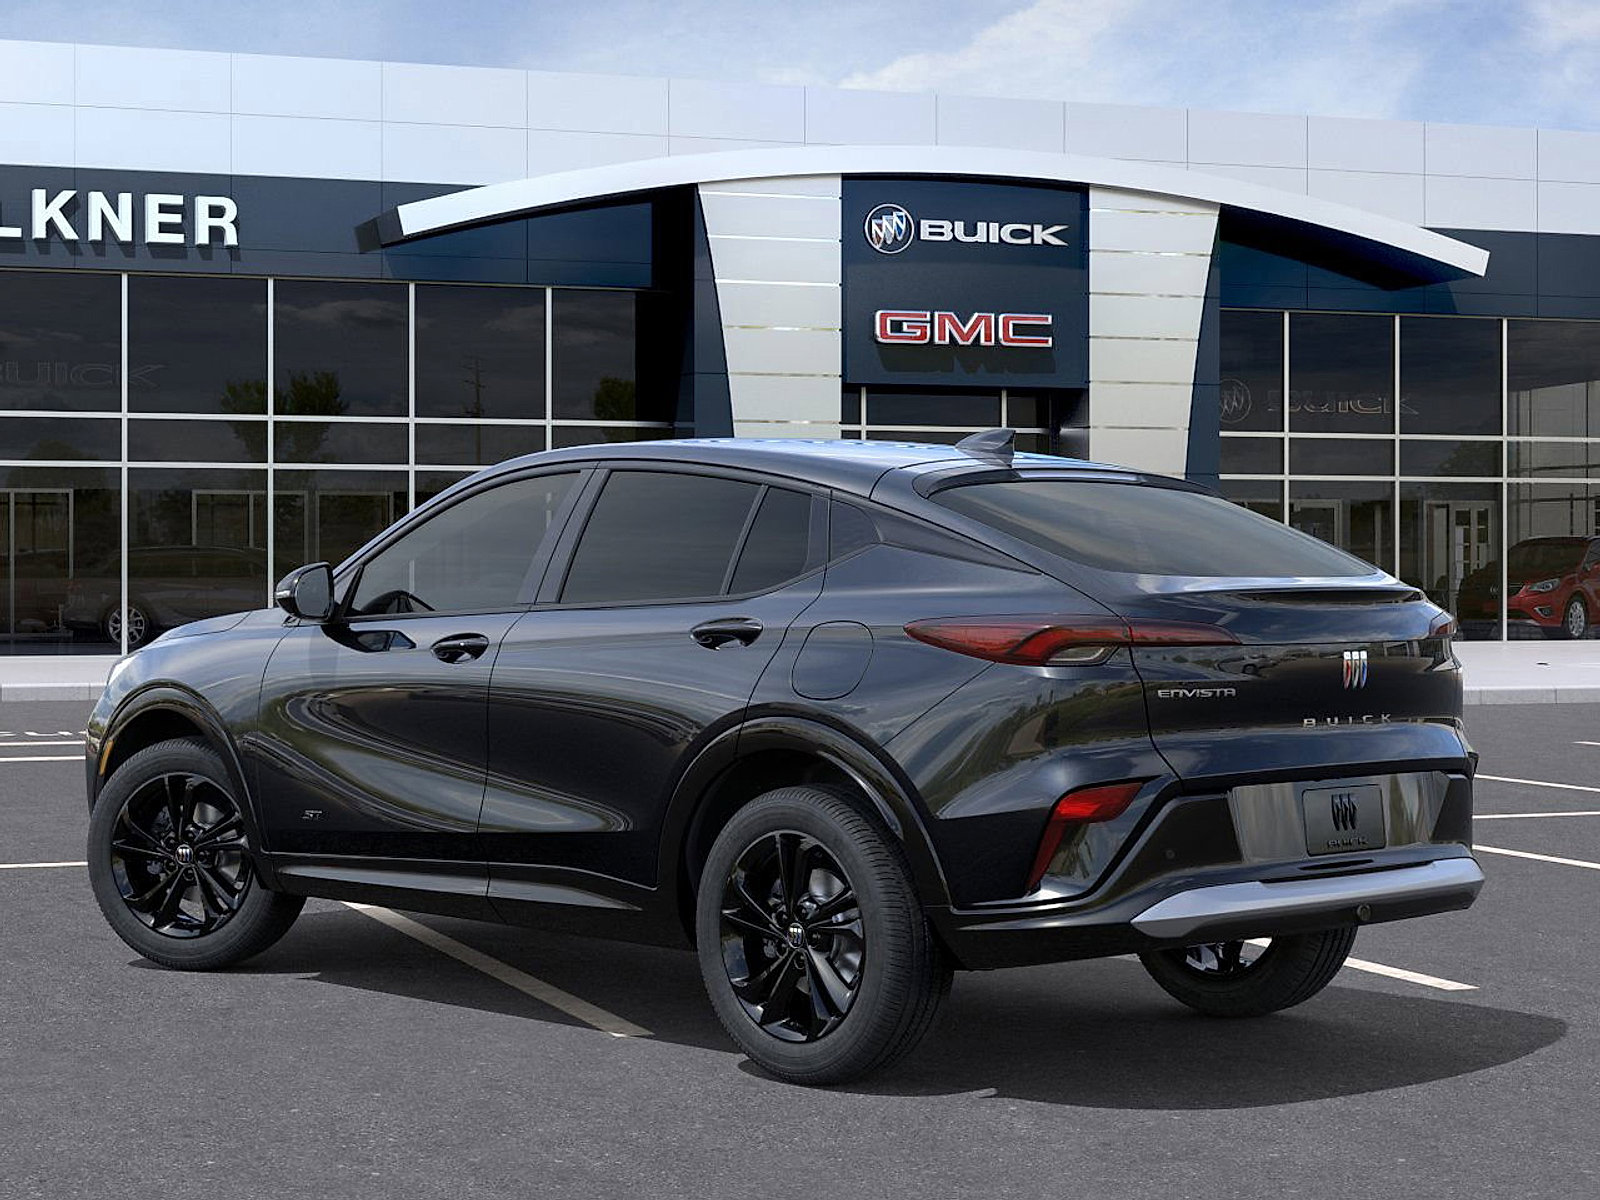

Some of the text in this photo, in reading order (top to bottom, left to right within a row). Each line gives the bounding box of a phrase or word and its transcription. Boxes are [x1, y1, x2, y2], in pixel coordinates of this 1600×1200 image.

[0, 188, 239, 247] KNER
[920, 219, 1069, 247] BUICK
[875, 310, 1052, 348] GMC
[0, 360, 167, 389] UICK
[1157, 687, 1237, 698] ENVISTA
[1303, 713, 1392, 728] BUICK
